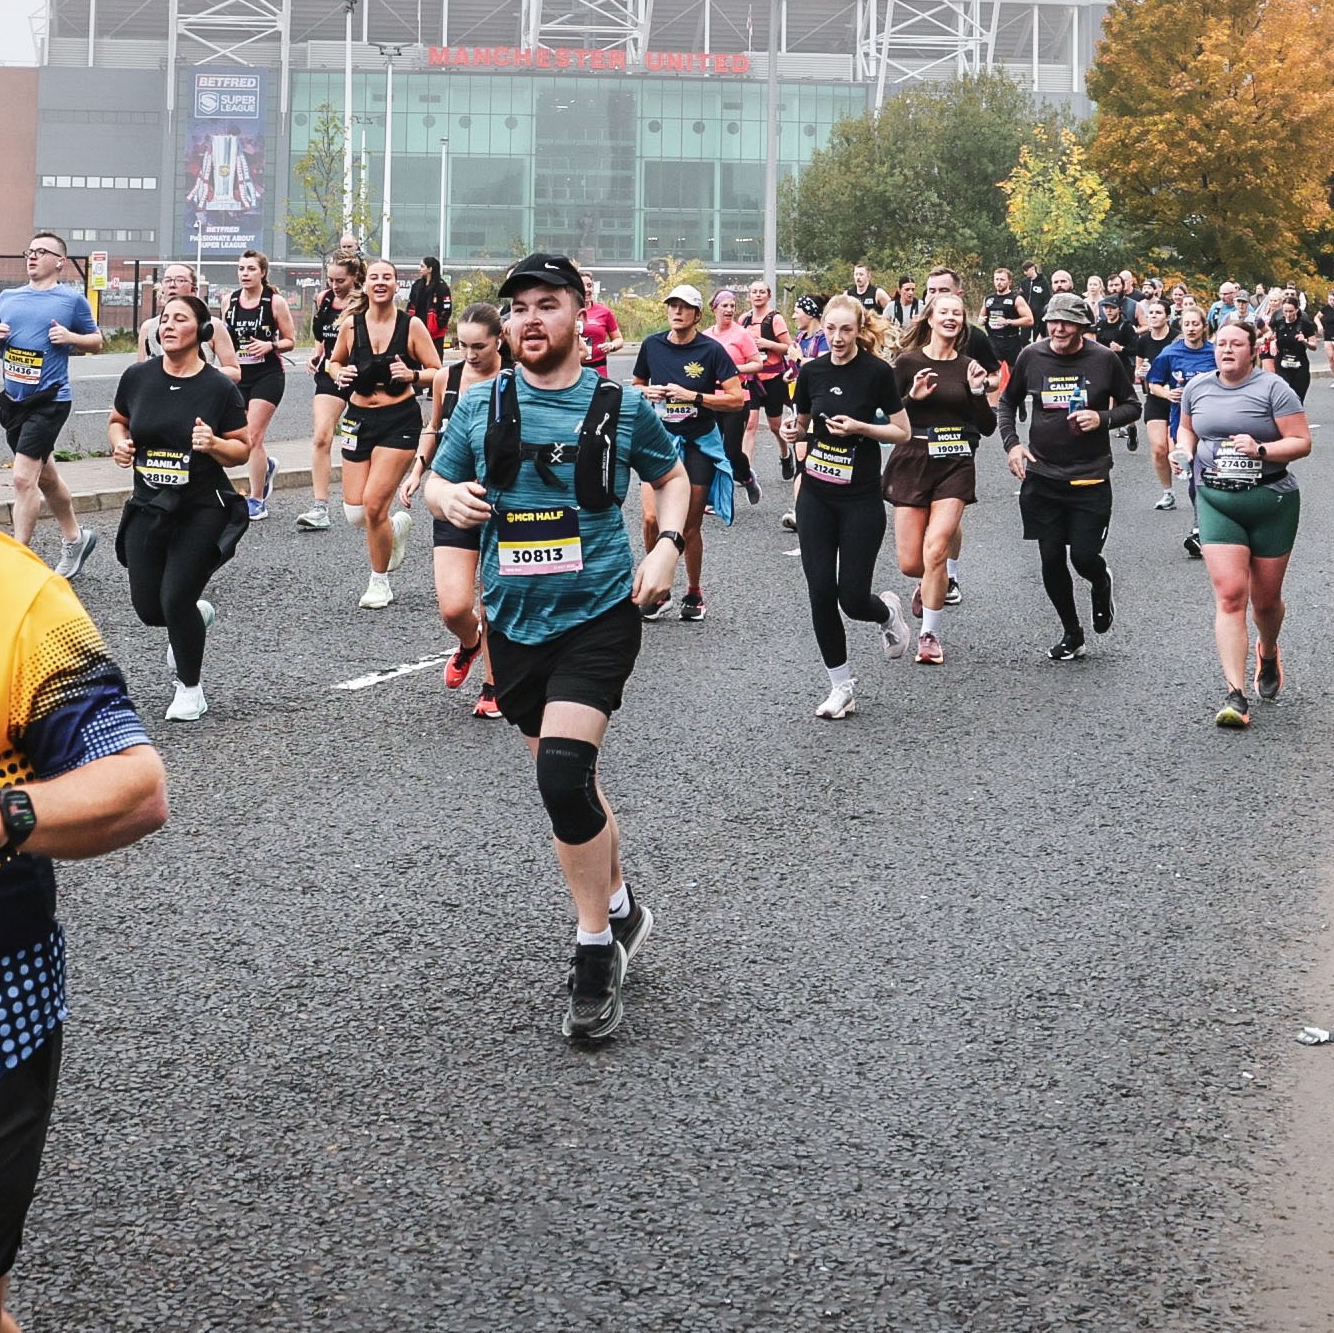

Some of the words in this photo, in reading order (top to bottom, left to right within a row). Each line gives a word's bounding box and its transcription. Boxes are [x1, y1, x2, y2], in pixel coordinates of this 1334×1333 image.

[428, 45, 626, 69] MANCHESTER
[645, 51, 750, 73] UNITED
[198, 77, 257, 87] BETFRED
[220, 95, 256, 105] SUPER
[189, 234, 230, 242] PASIONATE
[9, 365, 32, 375] 21436
[937, 444, 964, 453] 19099
[167, 451, 184, 459] HALF
[823, 452, 852, 464] DOHERTY
[146, 458, 182, 470] DANILA
[1221, 460, 1254, 468] 27408
[813, 463, 841, 477] 21242
[146, 473, 179, 483] 28192
[515, 512, 535, 522] MCR
[536, 510, 564, 521] HALF
[512, 548, 564, 564] 30813
